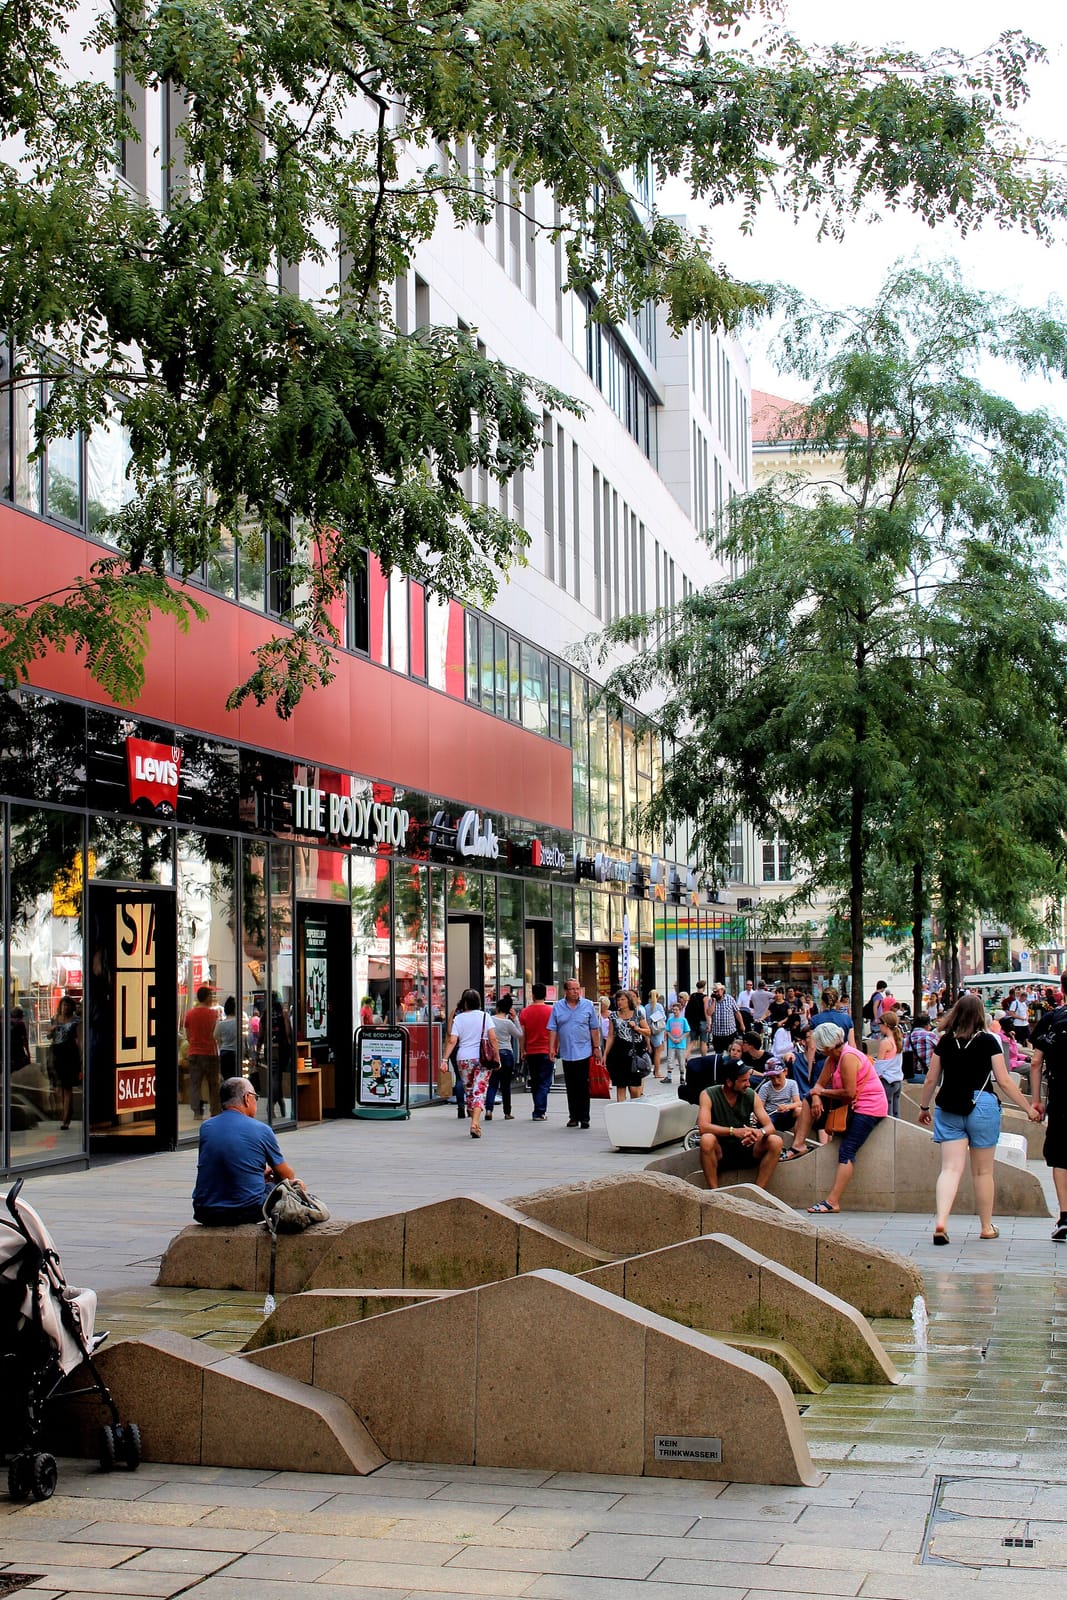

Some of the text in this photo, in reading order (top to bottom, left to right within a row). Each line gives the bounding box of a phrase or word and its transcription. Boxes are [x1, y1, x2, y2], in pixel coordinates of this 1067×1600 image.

[292, 785, 410, 848] THE BODY SHOP
[119, 1078, 145, 1100] SALE
[659, 1449, 718, 1459] TRINKWASSER!
